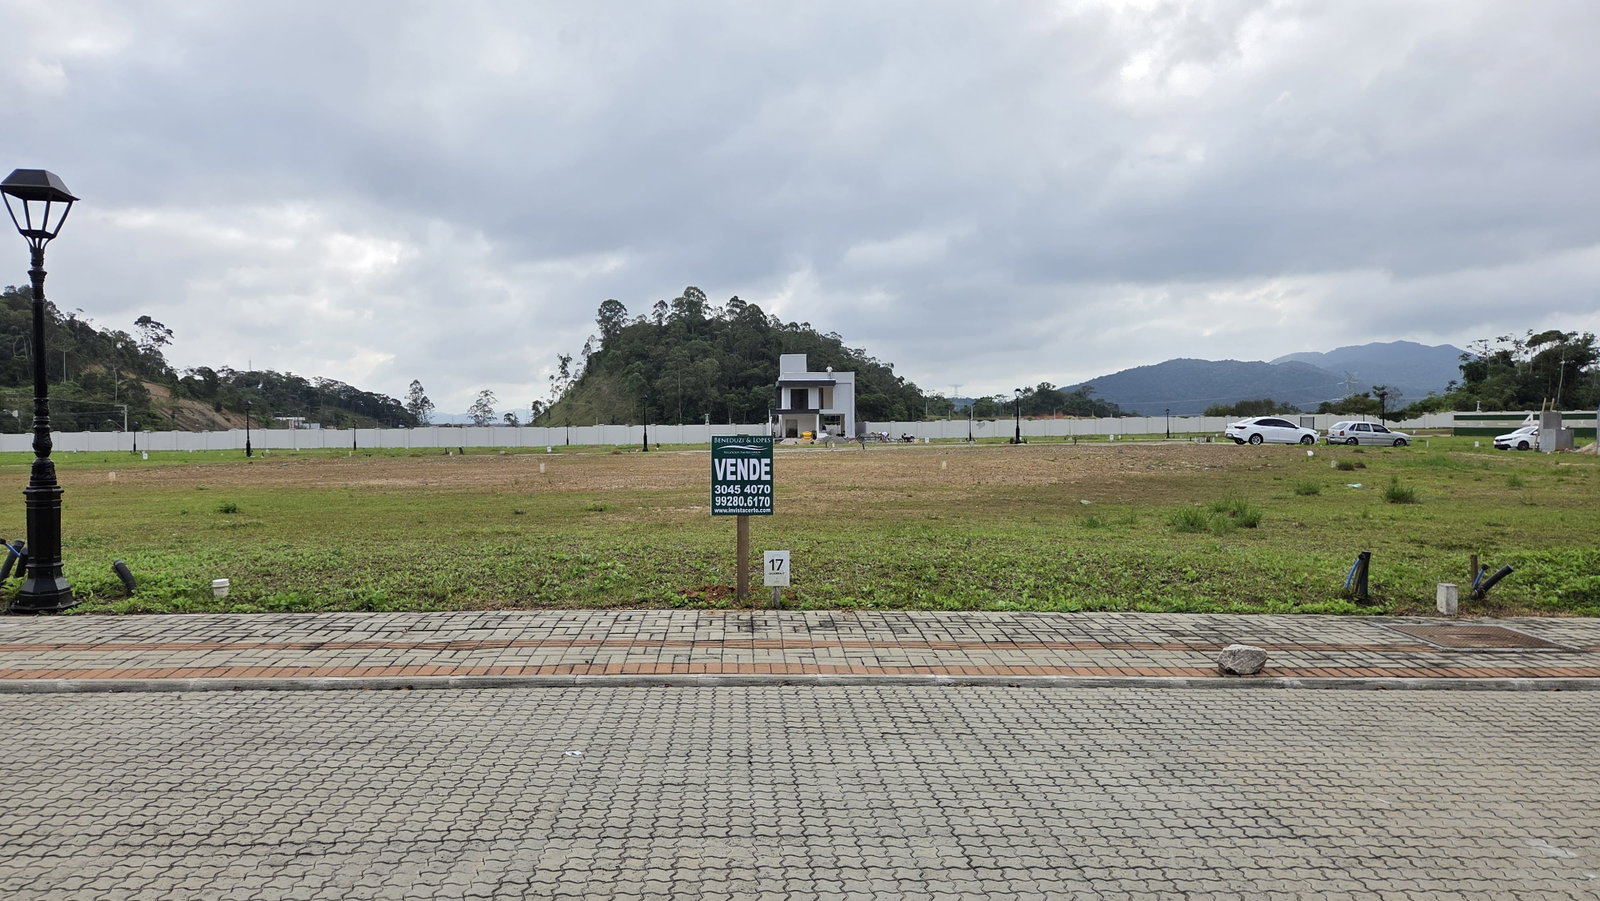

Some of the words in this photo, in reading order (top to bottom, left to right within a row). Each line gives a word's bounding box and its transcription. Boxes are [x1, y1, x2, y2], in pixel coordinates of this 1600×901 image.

[714, 458, 771, 481] VENDE
[714, 484, 741, 494] 3045
[743, 484, 771, 494] 4070
[715, 496, 771, 507] 99280.6170
[768, 558, 784, 571] 17
